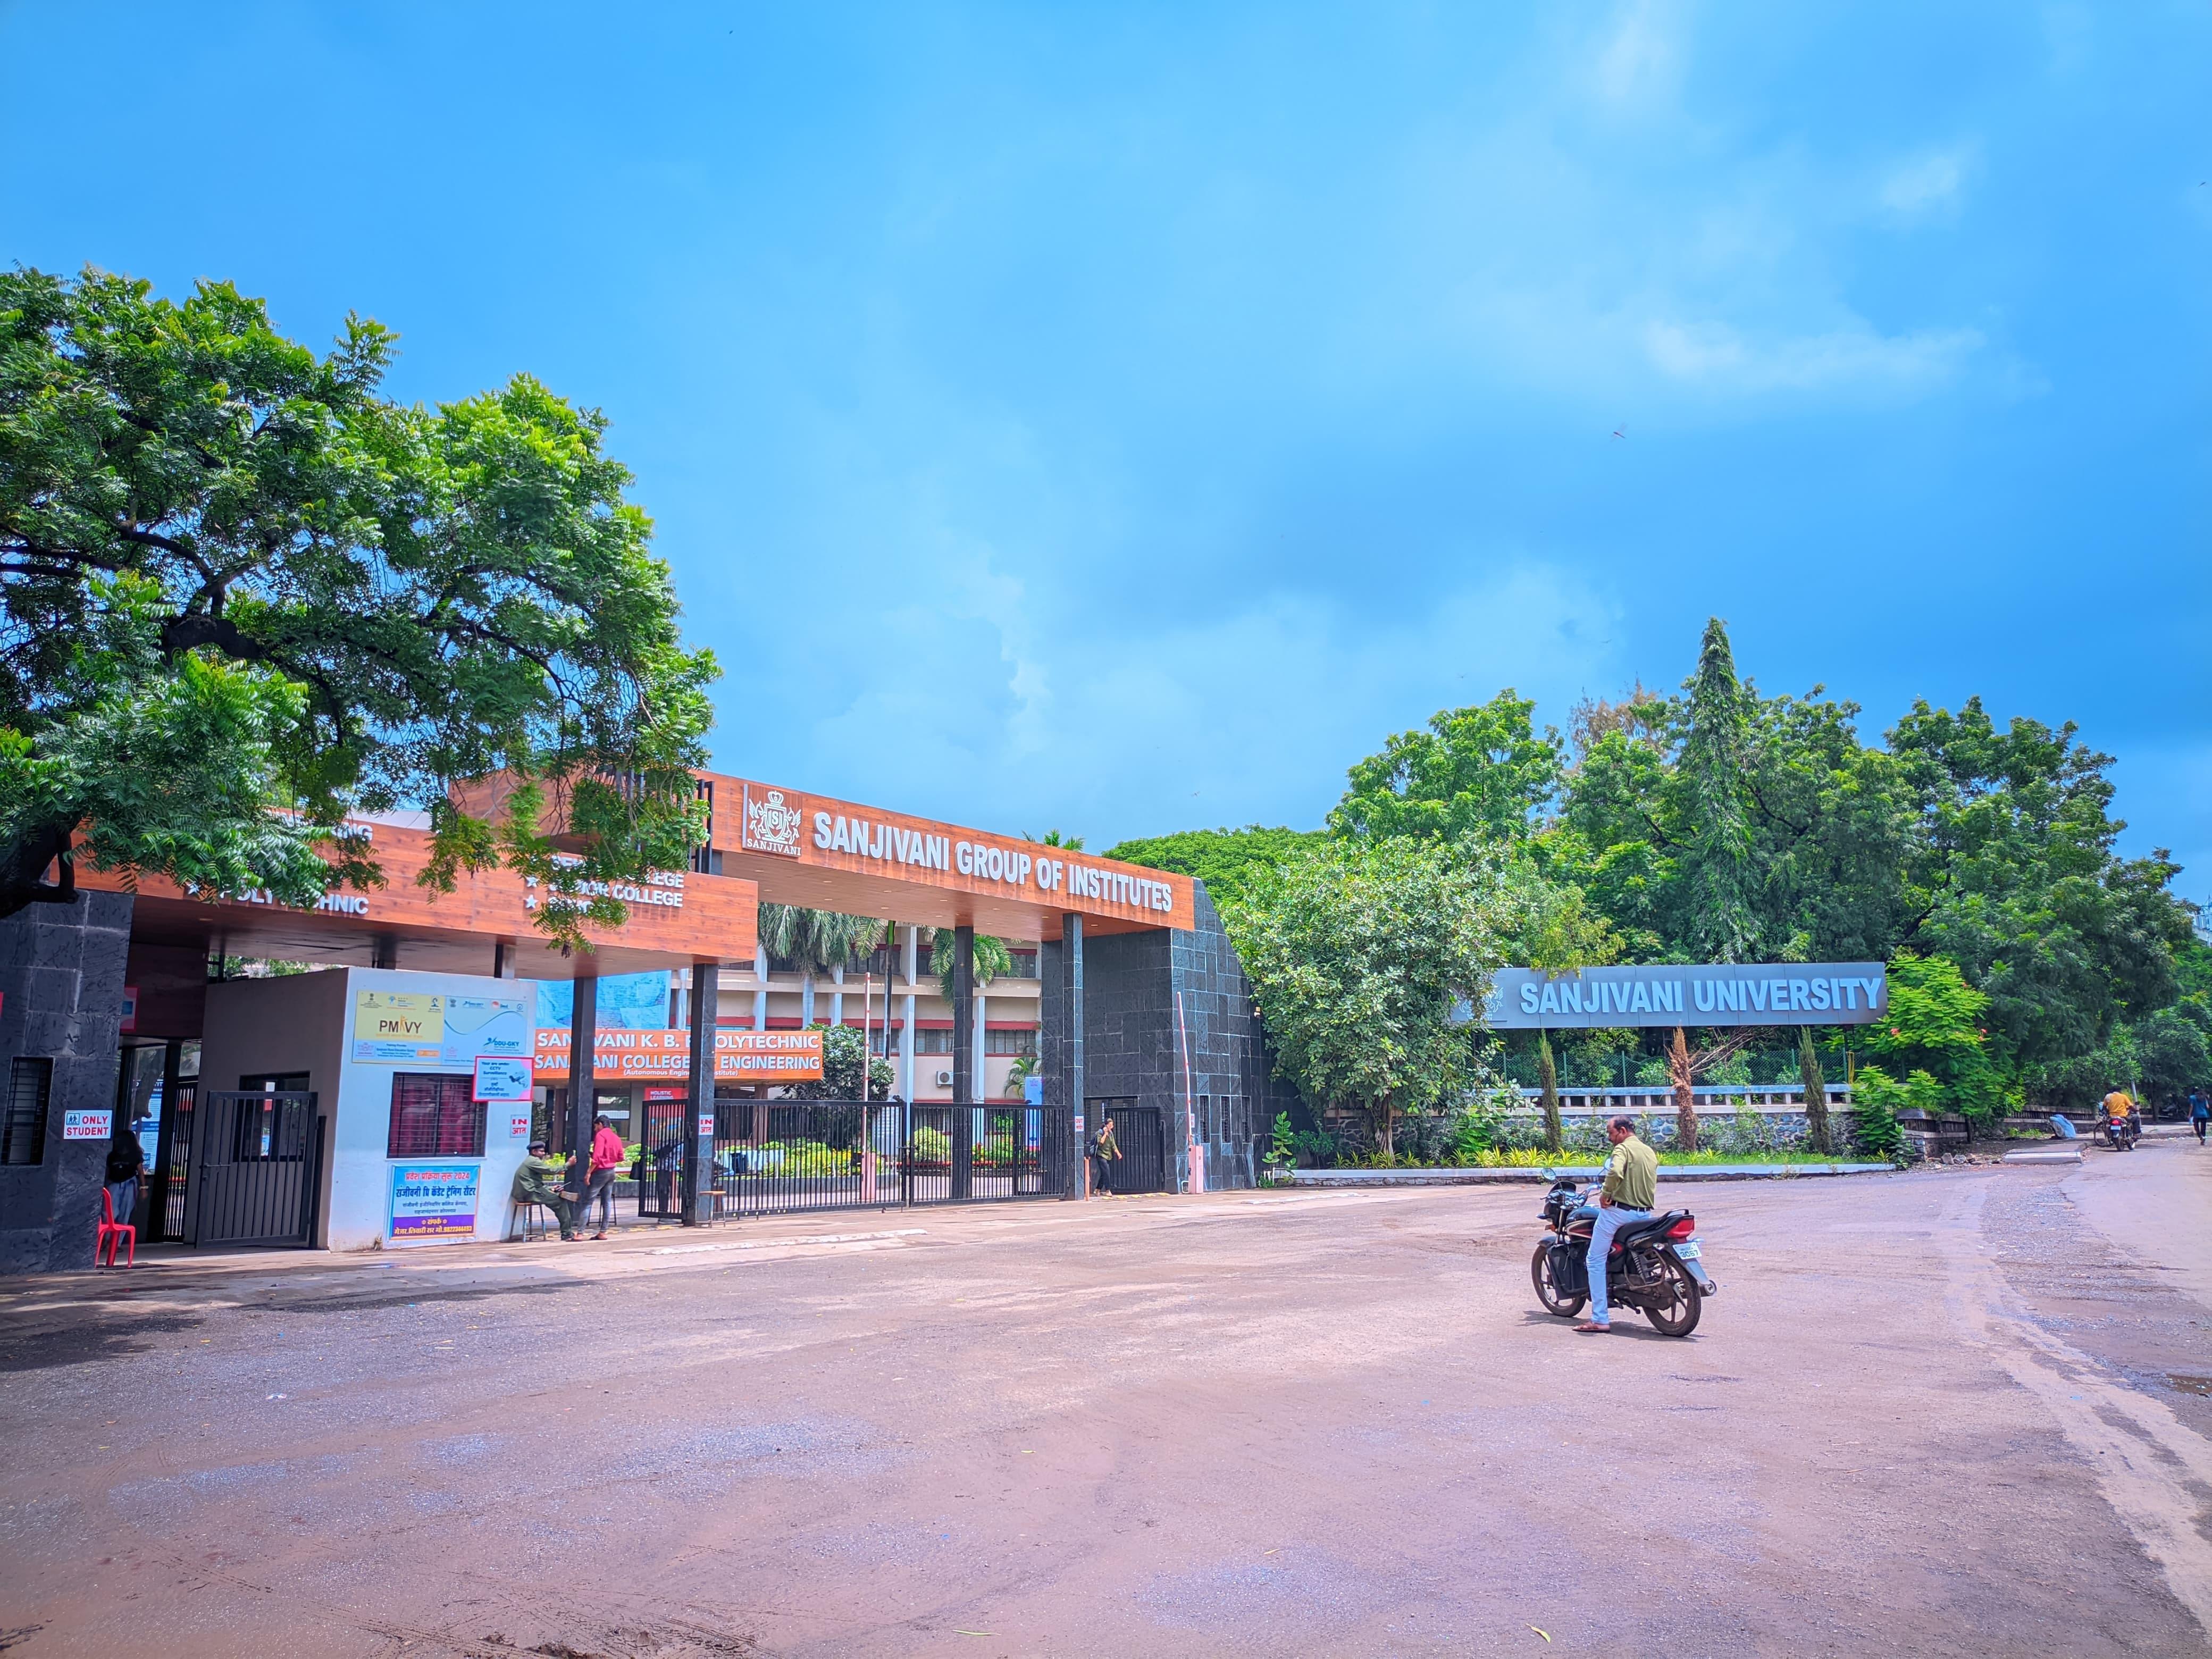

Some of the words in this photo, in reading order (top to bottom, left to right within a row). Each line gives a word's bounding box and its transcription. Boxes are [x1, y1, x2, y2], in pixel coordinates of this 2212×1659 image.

[747, 838, 801, 856] SANJIVANI
[814, 812, 949, 870] SANJIVANI
[956, 841, 1031, 885] GROUP
[1035, 858, 1063, 891] OF
[1068, 864, 1172, 912] INSTITUTES
[611, 884, 684, 907] COLLEGE
[1520, 982, 1684, 1014] SANJIVANI
[1693, 978, 1882, 1012] UNIVERSITY
[537, 1033, 636, 1048] SANVANI
[641, 1034, 659, 1048] K.
[664, 1034, 680, 1048] B.
[715, 1035, 819, 1049] OLYTECHNIC
[534, 1054, 618, 1069] SANANI
[623, 1055, 690, 1069] COLLEGE
[721, 1055, 820, 1070] ENGINEERING
[82, 1116, 108, 1125] ONLY
[66, 1127, 109, 1136] STUDENT
[396, 1185, 421, 1197] संजीवनी
